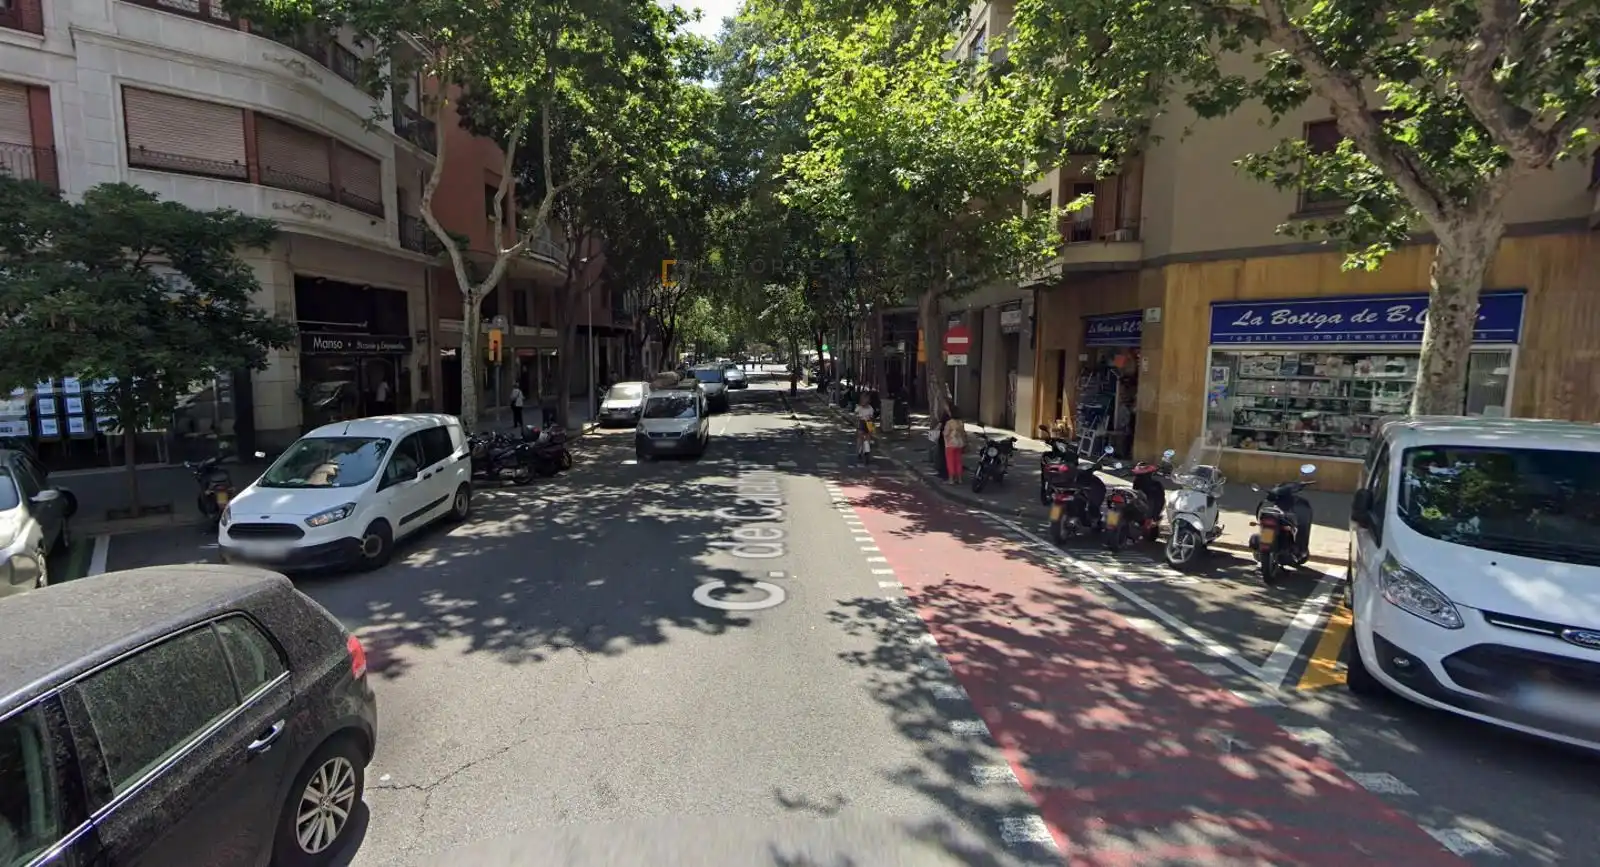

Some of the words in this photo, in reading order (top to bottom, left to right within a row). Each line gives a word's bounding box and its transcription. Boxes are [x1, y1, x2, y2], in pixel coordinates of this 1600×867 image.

[1231, 310, 1265, 327] La
[1270, 308, 1343, 330] Botiga
[1350, 307, 1379, 323] de
[313, 336, 344, 350] Manso
